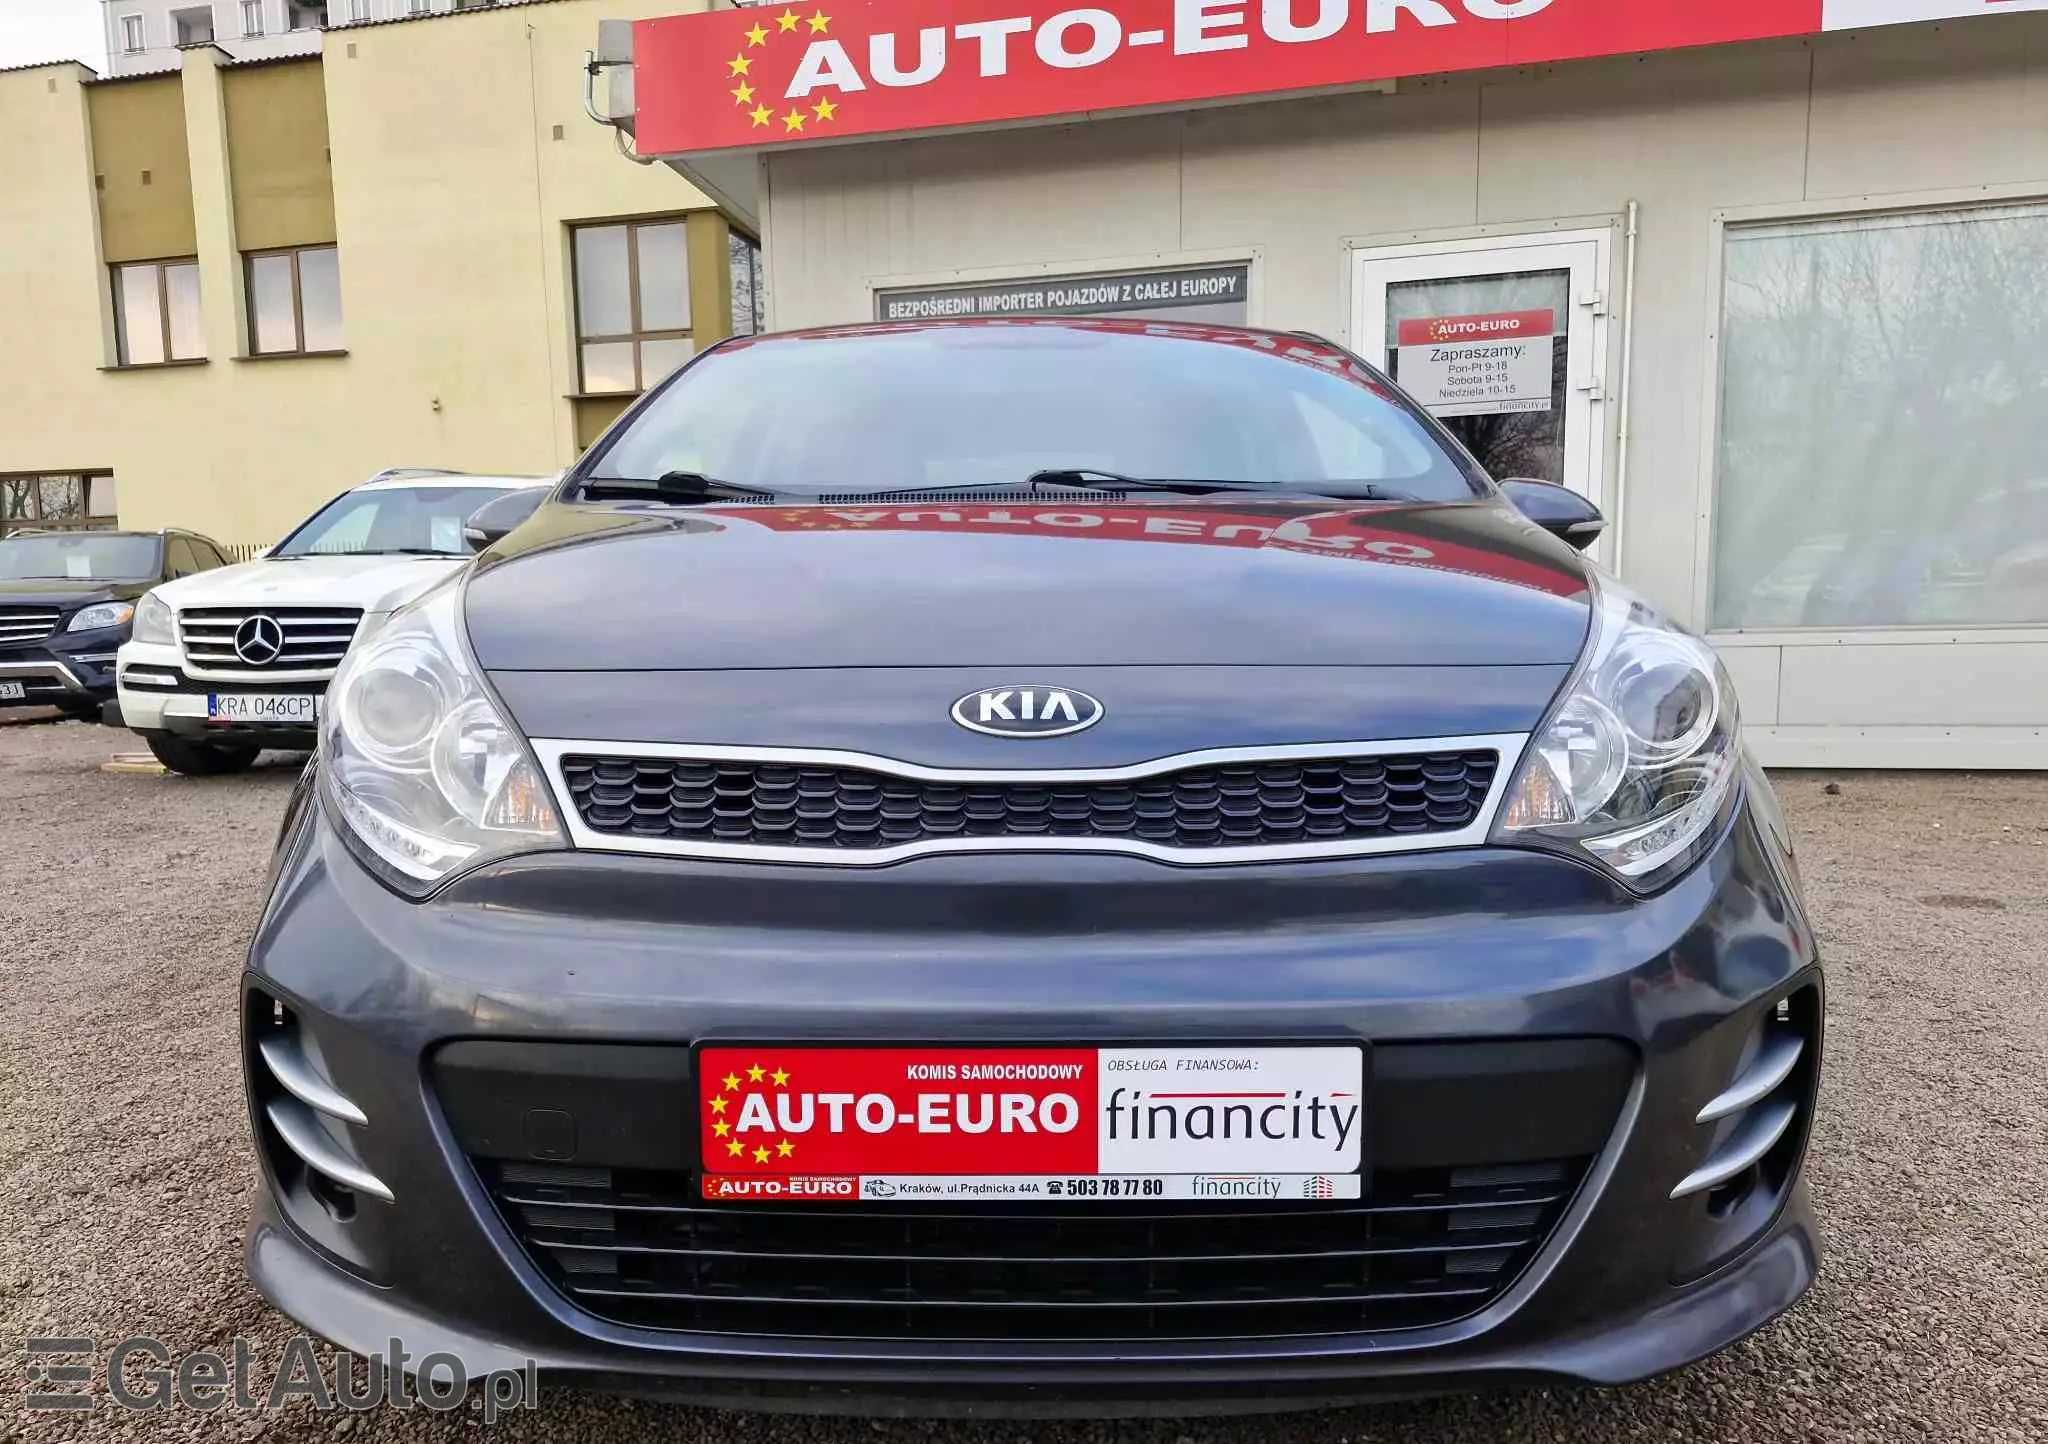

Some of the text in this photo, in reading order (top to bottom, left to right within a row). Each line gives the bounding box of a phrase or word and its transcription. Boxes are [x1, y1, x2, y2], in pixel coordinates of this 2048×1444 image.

[889, 276, 1237, 318] BEZPOŚREDNI IMPORTER POJAZDÓW Z CAŁEJ EUROPY
[1438, 319, 1520, 334] AUTO-EURO
[1431, 345, 1526, 363] Zapraszamy:
[1448, 361, 1508, 374] Pon-Pt 9-18
[1448, 373, 1508, 386] Sobota 9-15
[1440, 384, 1516, 398] Niedziela 10-15
[217, 697, 248, 716] KRA
[254, 697, 311, 716] 046CP
[979, 690, 1079, 722] KIA
[907, 1064, 1083, 1080] KOMIS SAMOCHODOWY
[1107, 1059, 1260, 1071] OBSŁUGA FINANSOWA:
[735, 1092, 1080, 1134] AUTO-EURO
[1106, 1088, 1359, 1152] financity
[719, 1181, 853, 1194] AUTO-EURO
[900, 1183, 943, 1194] Kraków,
[1019, 1183, 1040, 1193] 44A
[1067, 1179, 1098, 1195] 503
[1101, 1179, 1120, 1195] 78
[1123, 1179, 1139, 1195] 77
[1143, 1179, 1163, 1195] 80
[1192, 1175, 1282, 1198] financity
